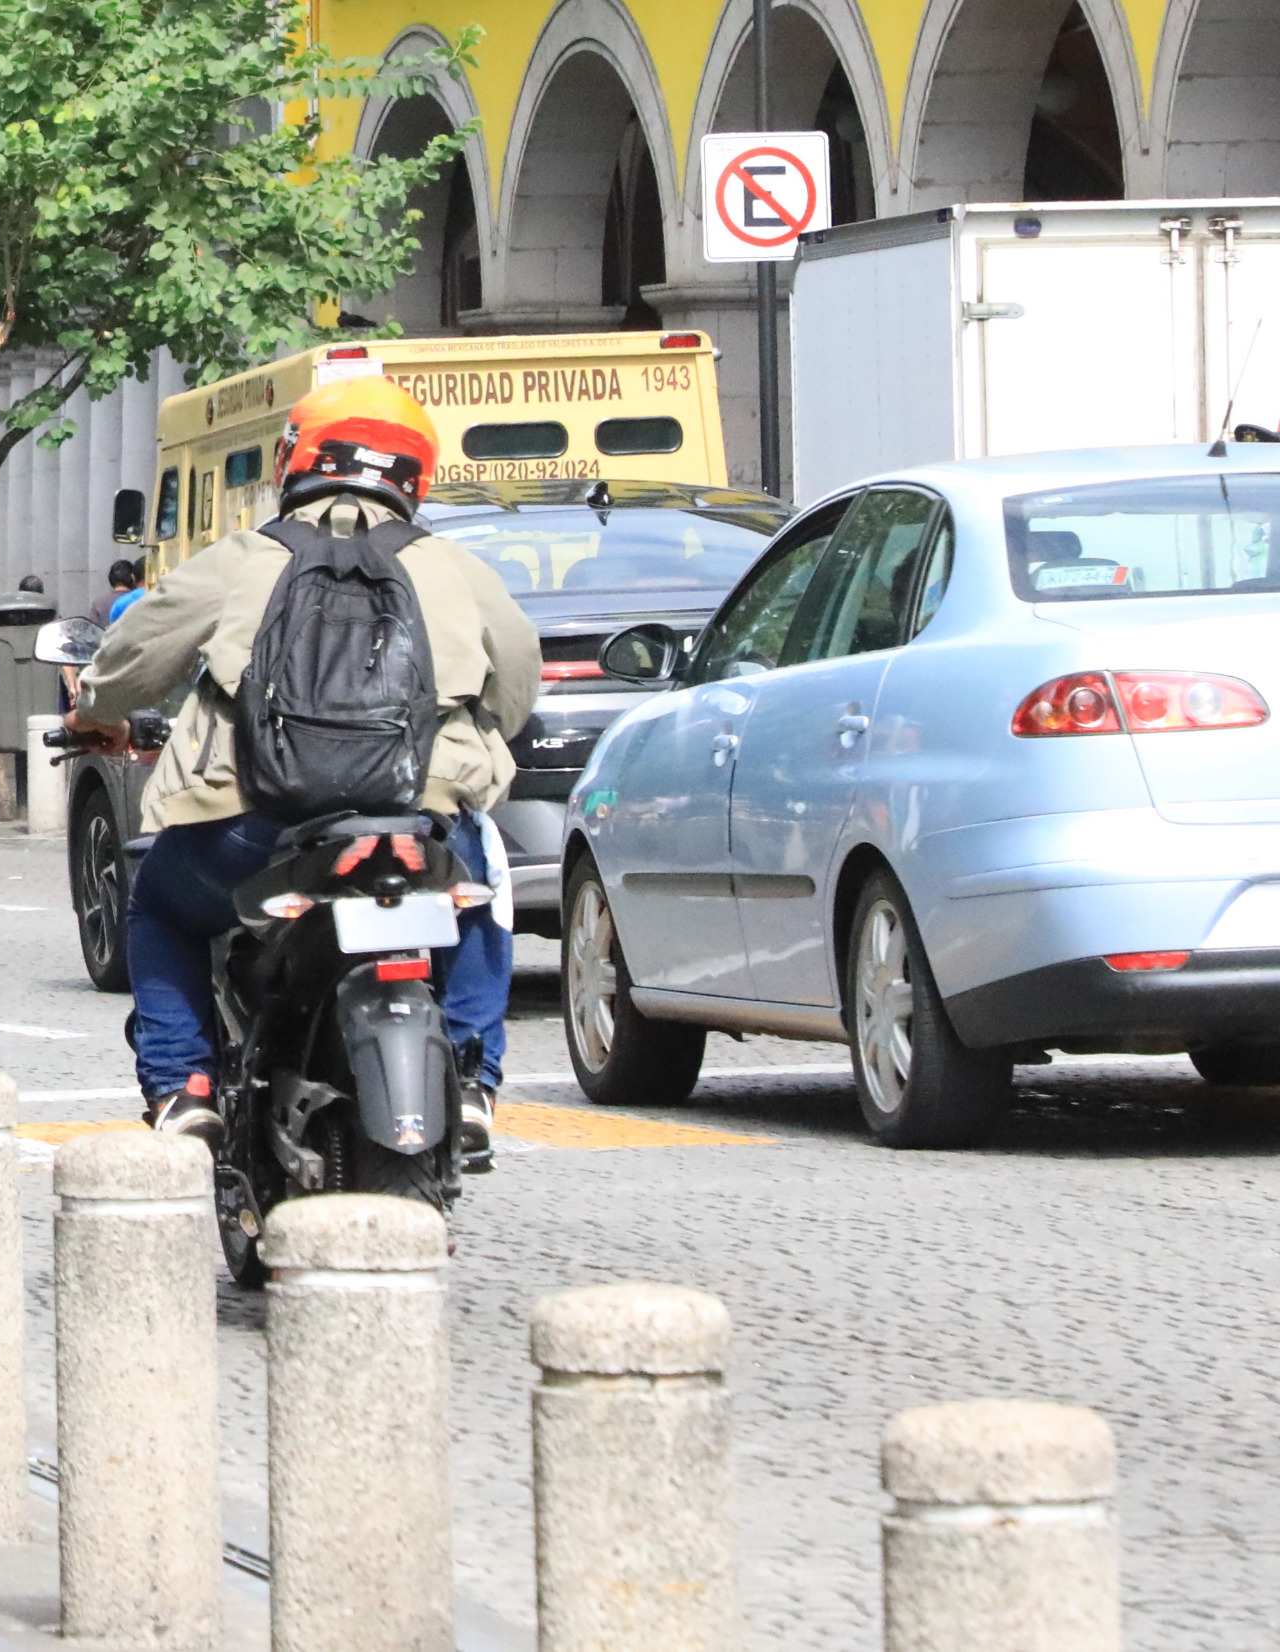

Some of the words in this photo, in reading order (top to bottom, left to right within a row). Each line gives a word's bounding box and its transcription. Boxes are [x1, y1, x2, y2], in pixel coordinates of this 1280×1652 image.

[486, 342, 495, 351] DE
[385, 371, 514, 407] EGURIDAD
[523, 367, 622, 403] PRIVADA
[641, 364, 691, 392] 1943
